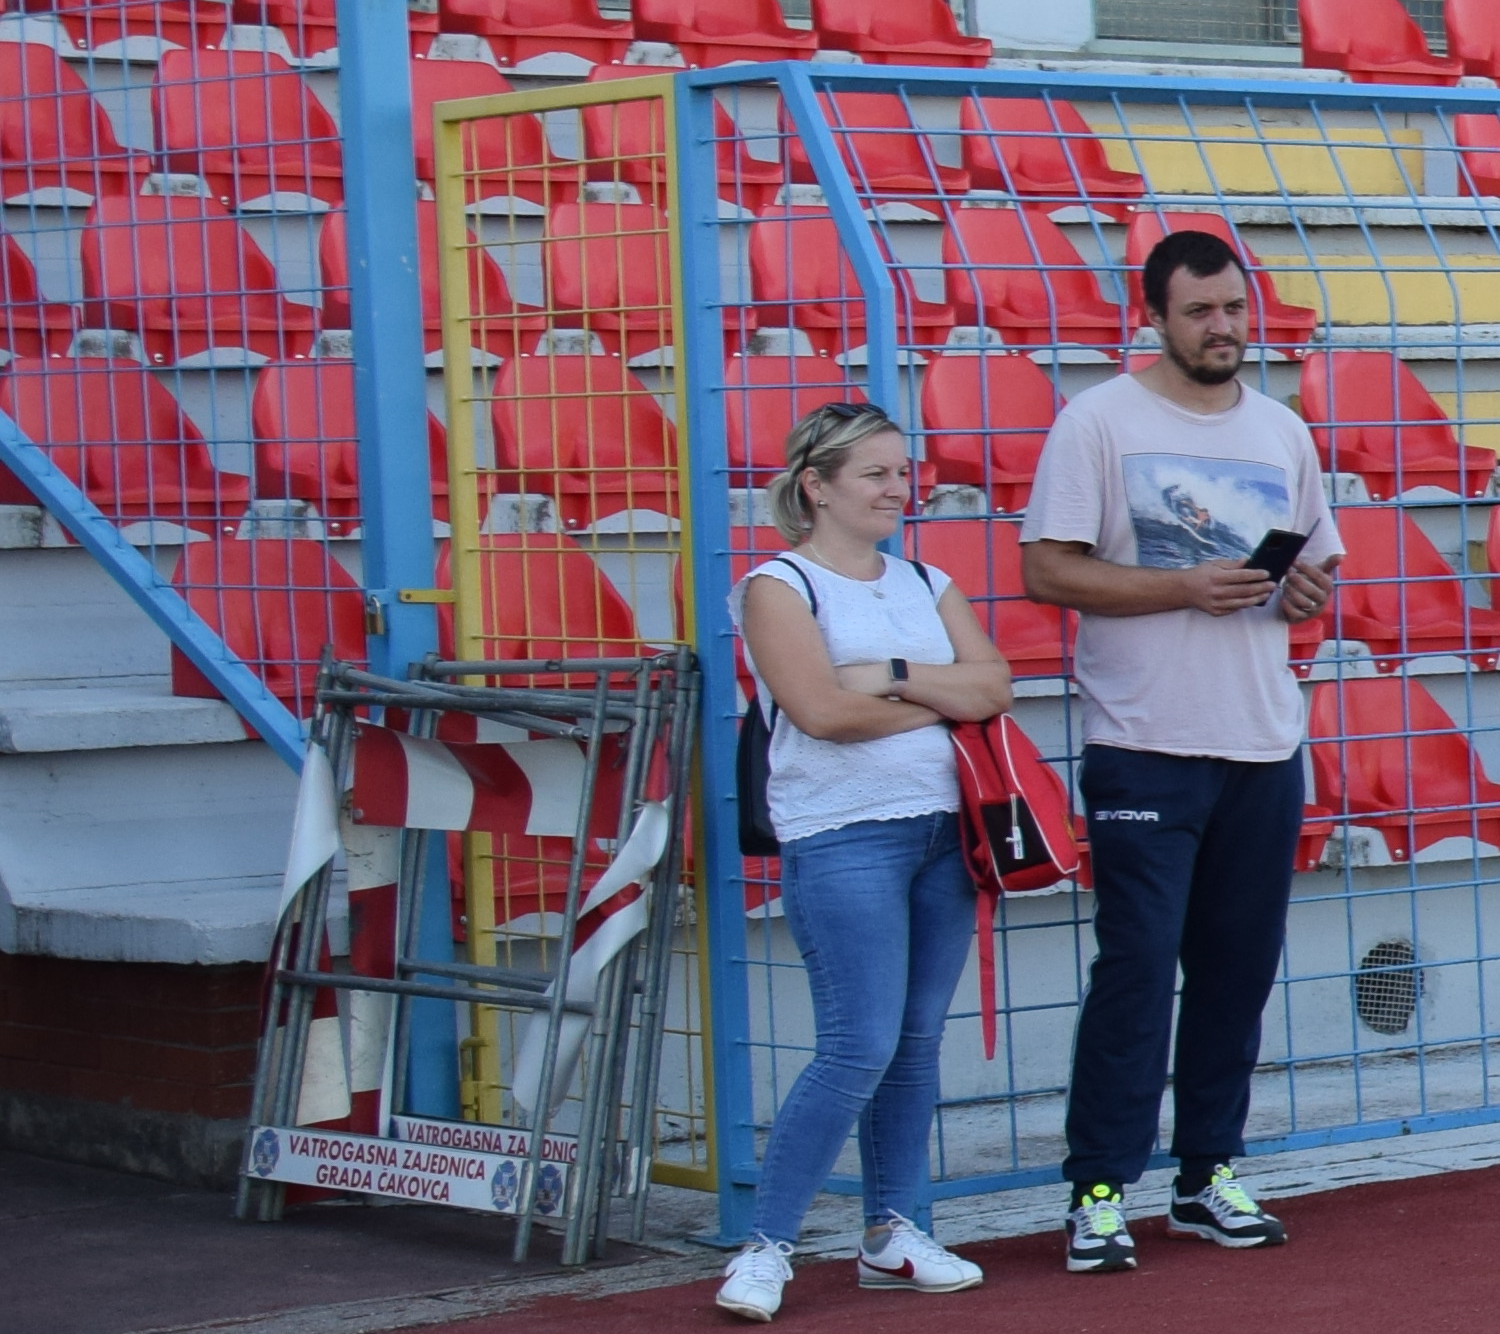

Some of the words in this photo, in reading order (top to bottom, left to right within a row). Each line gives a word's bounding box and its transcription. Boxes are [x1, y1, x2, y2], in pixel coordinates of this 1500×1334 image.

[289, 1134, 398, 1167] VATROGASNA
[402, 1149, 485, 1180] ZAJEDNICA
[407, 1122, 502, 1152] VATROGASNA
[508, 1134, 578, 1162] ZADNIC
[316, 1164, 372, 1190] GRADA
[377, 1167, 449, 1202] ČAKOVCA
